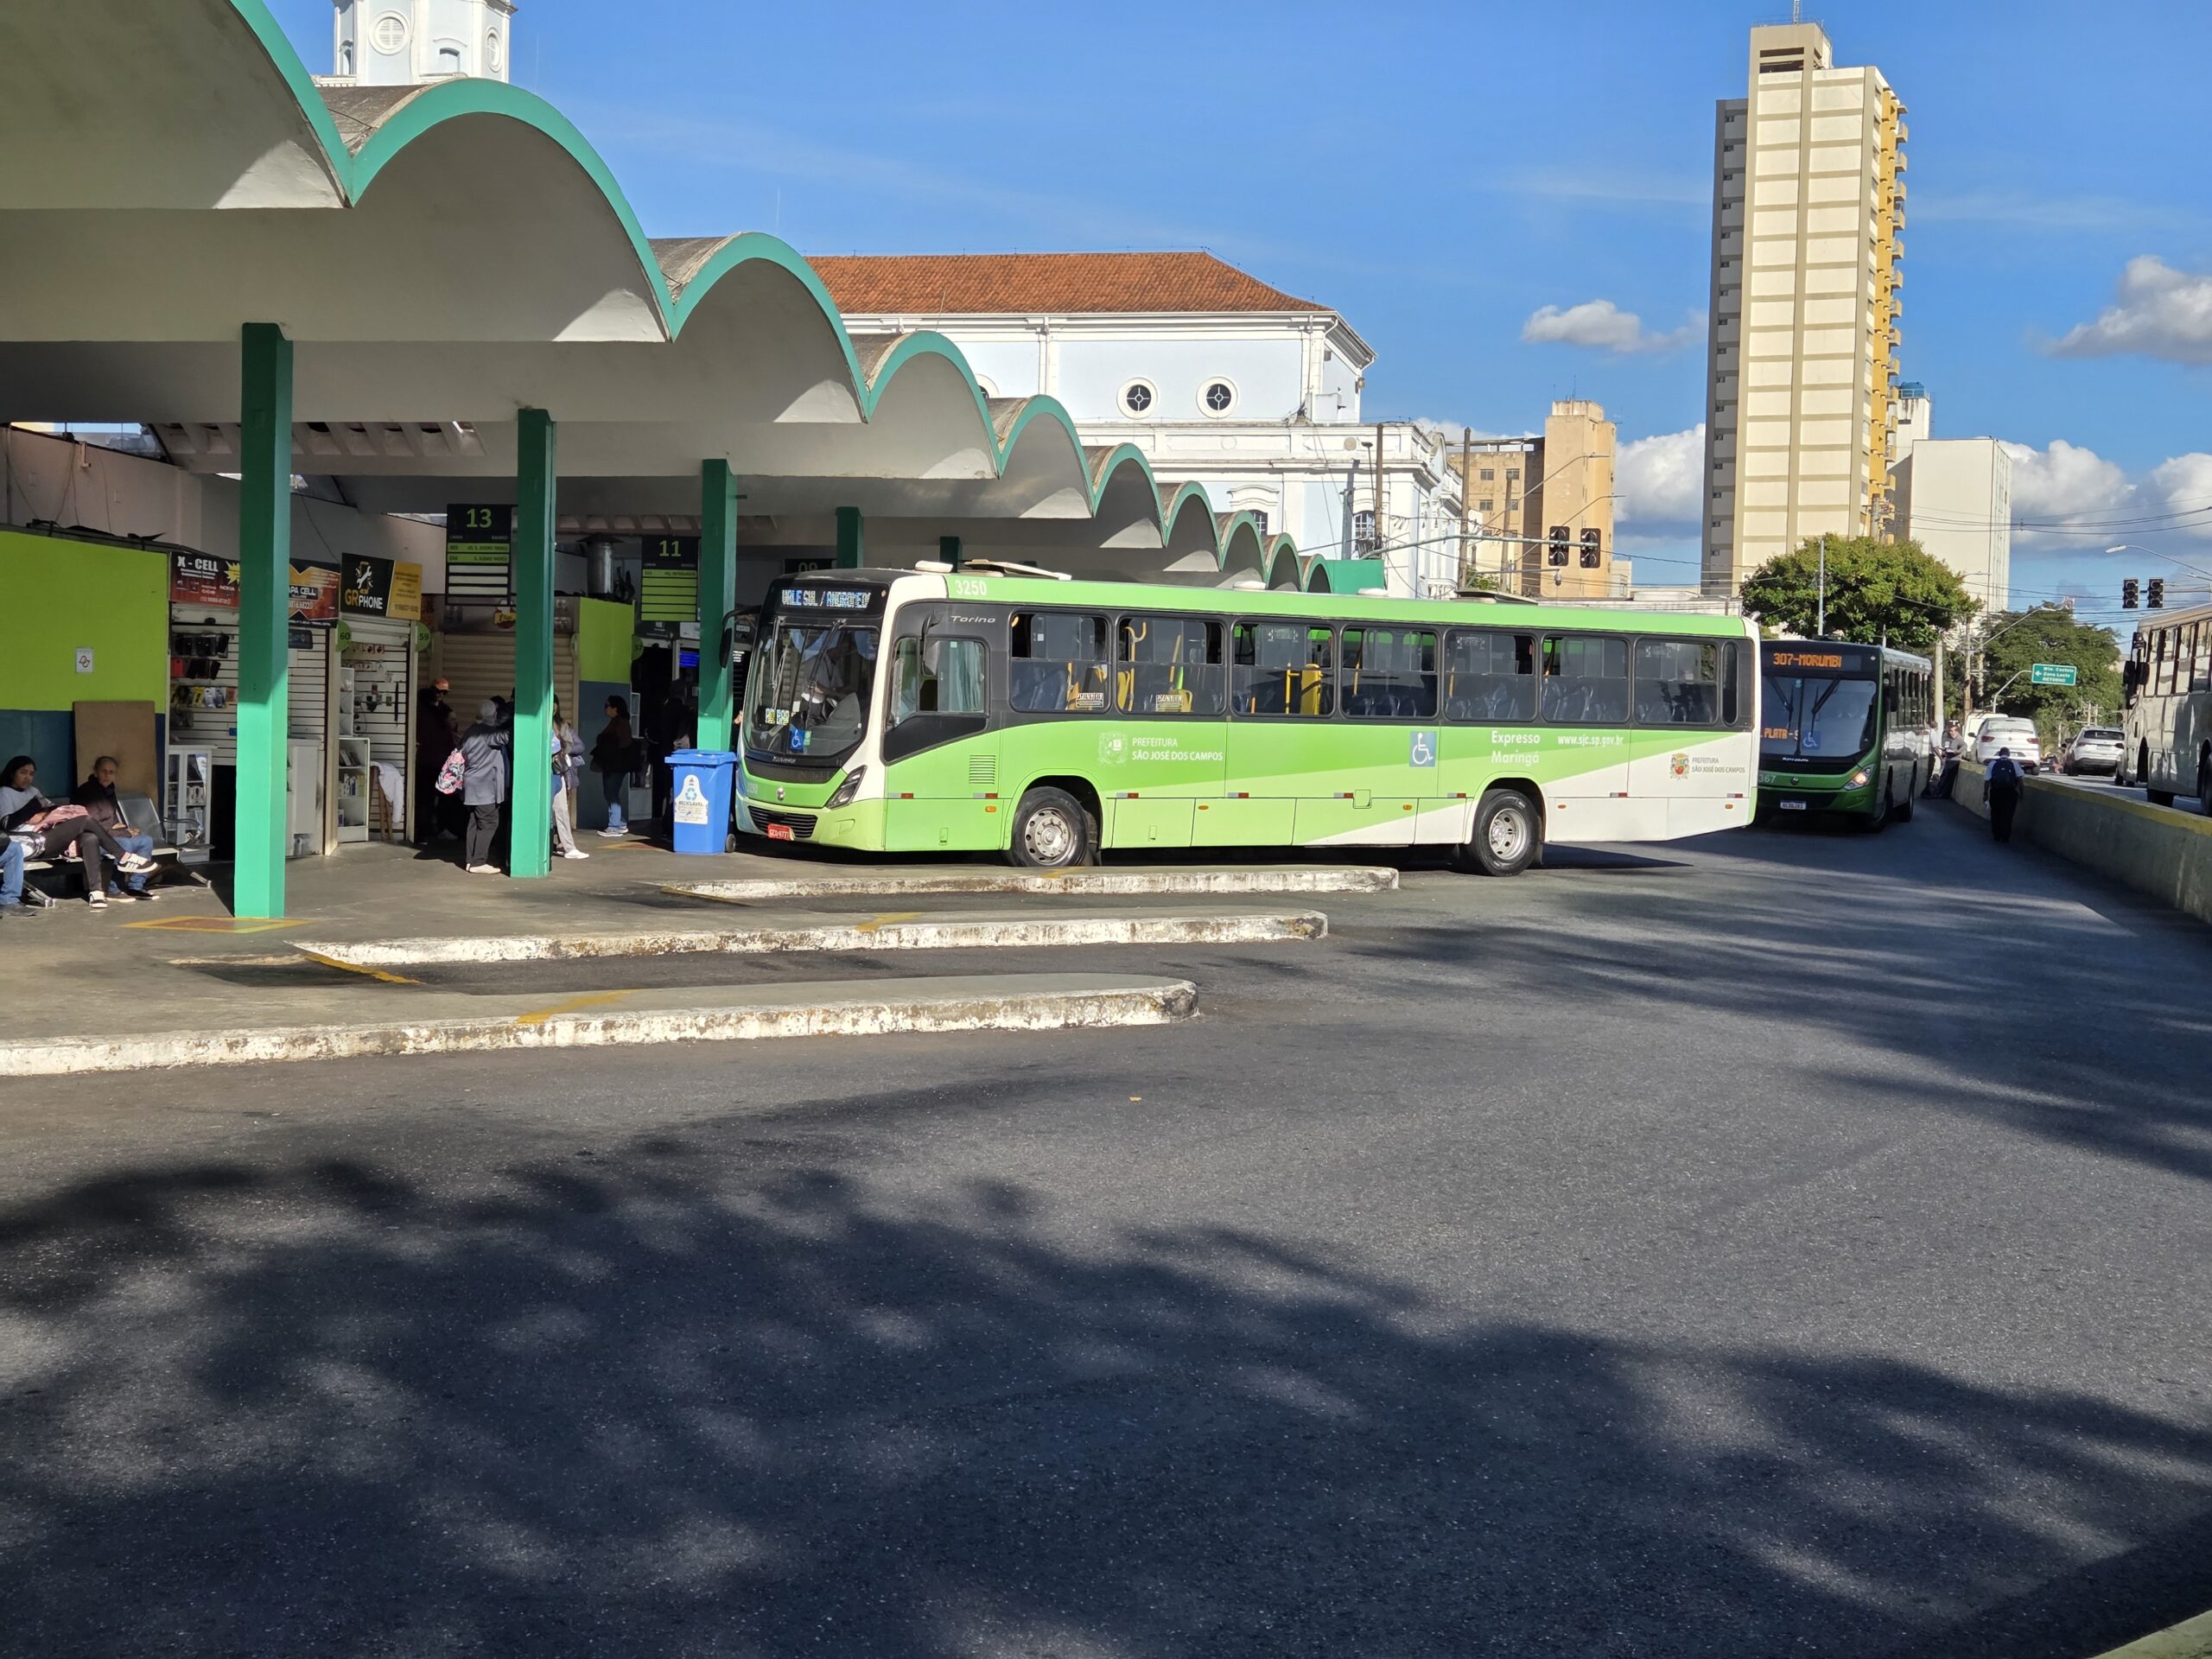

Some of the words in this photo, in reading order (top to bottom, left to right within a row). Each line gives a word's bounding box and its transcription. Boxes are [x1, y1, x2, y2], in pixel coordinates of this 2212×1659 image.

[467, 508, 492, 528] 13
[659, 540, 681, 556] 11
[177, 556, 186, 568] X
[194, 558, 219, 572] CELL
[300, 588, 316, 596] CELL
[954, 580, 987, 596] 3250
[781, 589, 803, 606] VALE
[803, 590, 818, 607] SUL
[1132, 737, 1179, 747] PREFEITURA
[1491, 730, 1541, 747] Expresso
[1557, 734, 1624, 747] www.sjc.sp.gov.br
[1132, 749, 1149, 760] SÃO
[1150, 749, 1170, 760] JOSÉ
[1171, 751, 1188, 760] DOS
[1189, 751, 1224, 761] CAMPOS
[1702, 765, 1713, 773] JOSÉ
